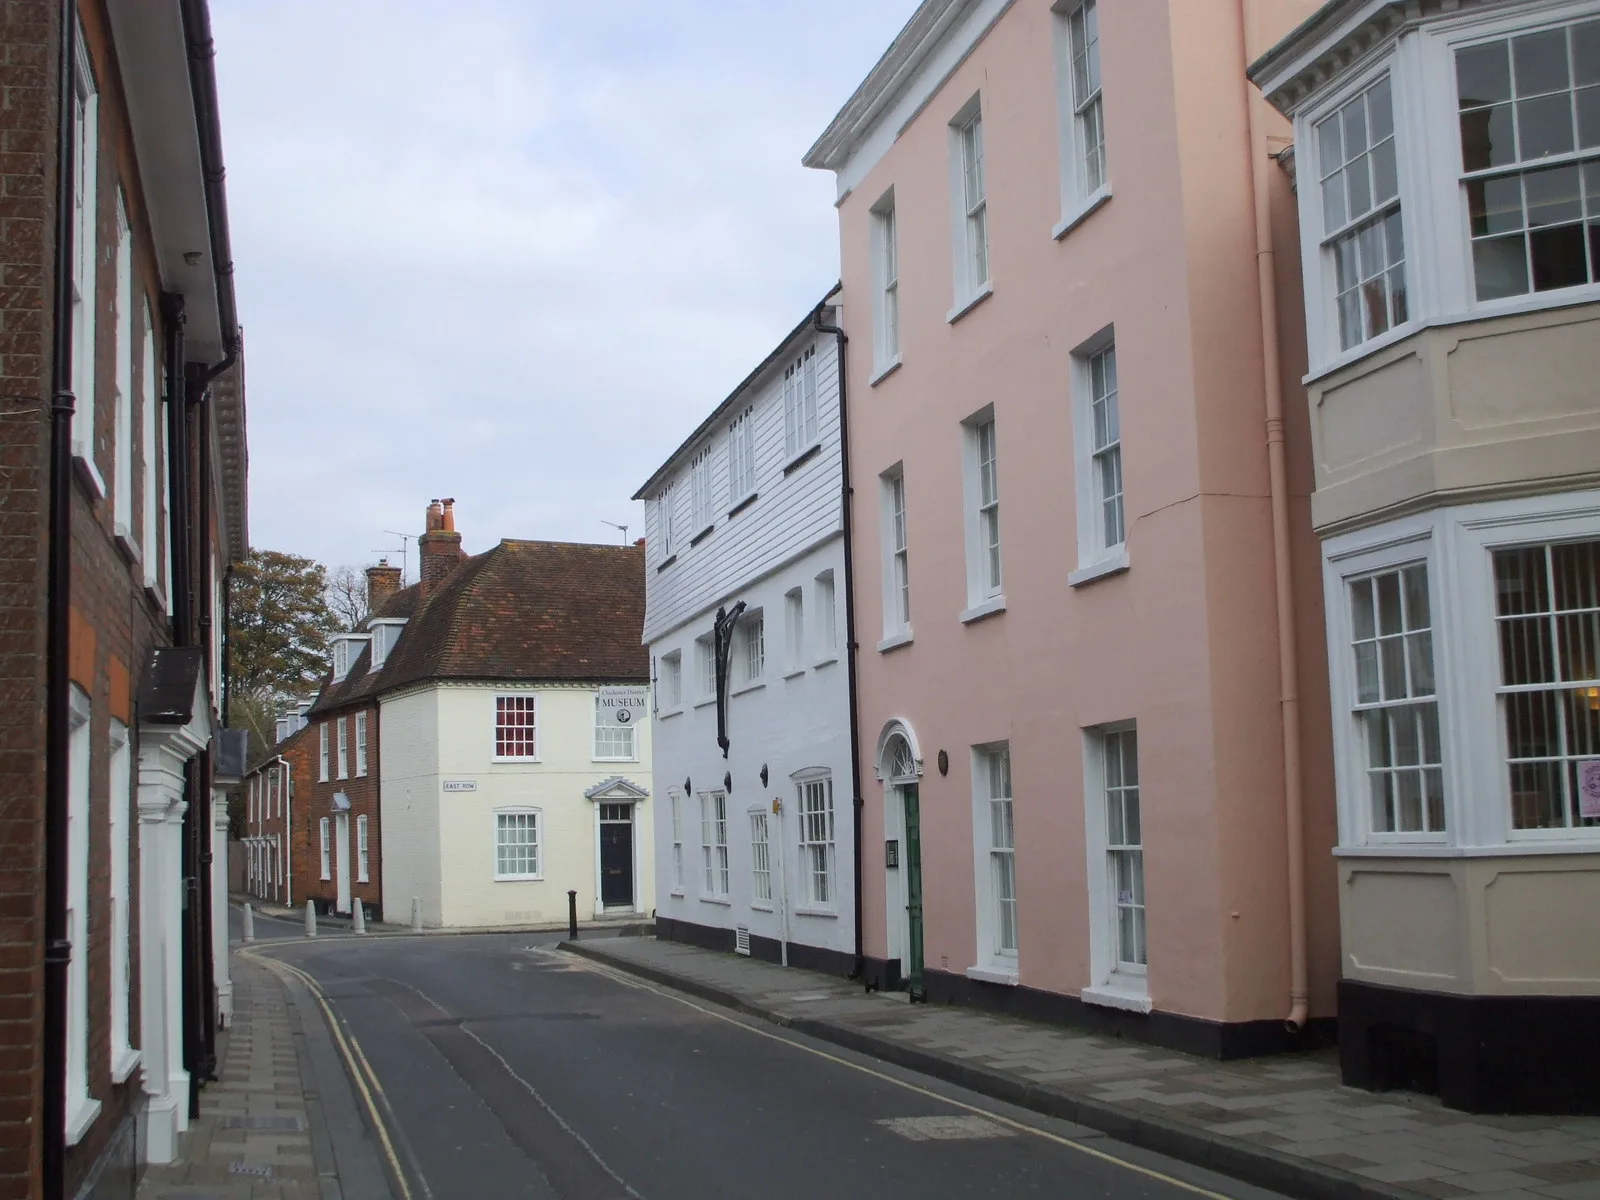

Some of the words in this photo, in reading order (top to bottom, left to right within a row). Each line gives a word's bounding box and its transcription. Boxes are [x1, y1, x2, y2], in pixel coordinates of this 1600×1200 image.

[602, 698, 645, 707] MUSEUM
[446, 782, 460, 790] EAST
[463, 782, 475, 790] ROW
